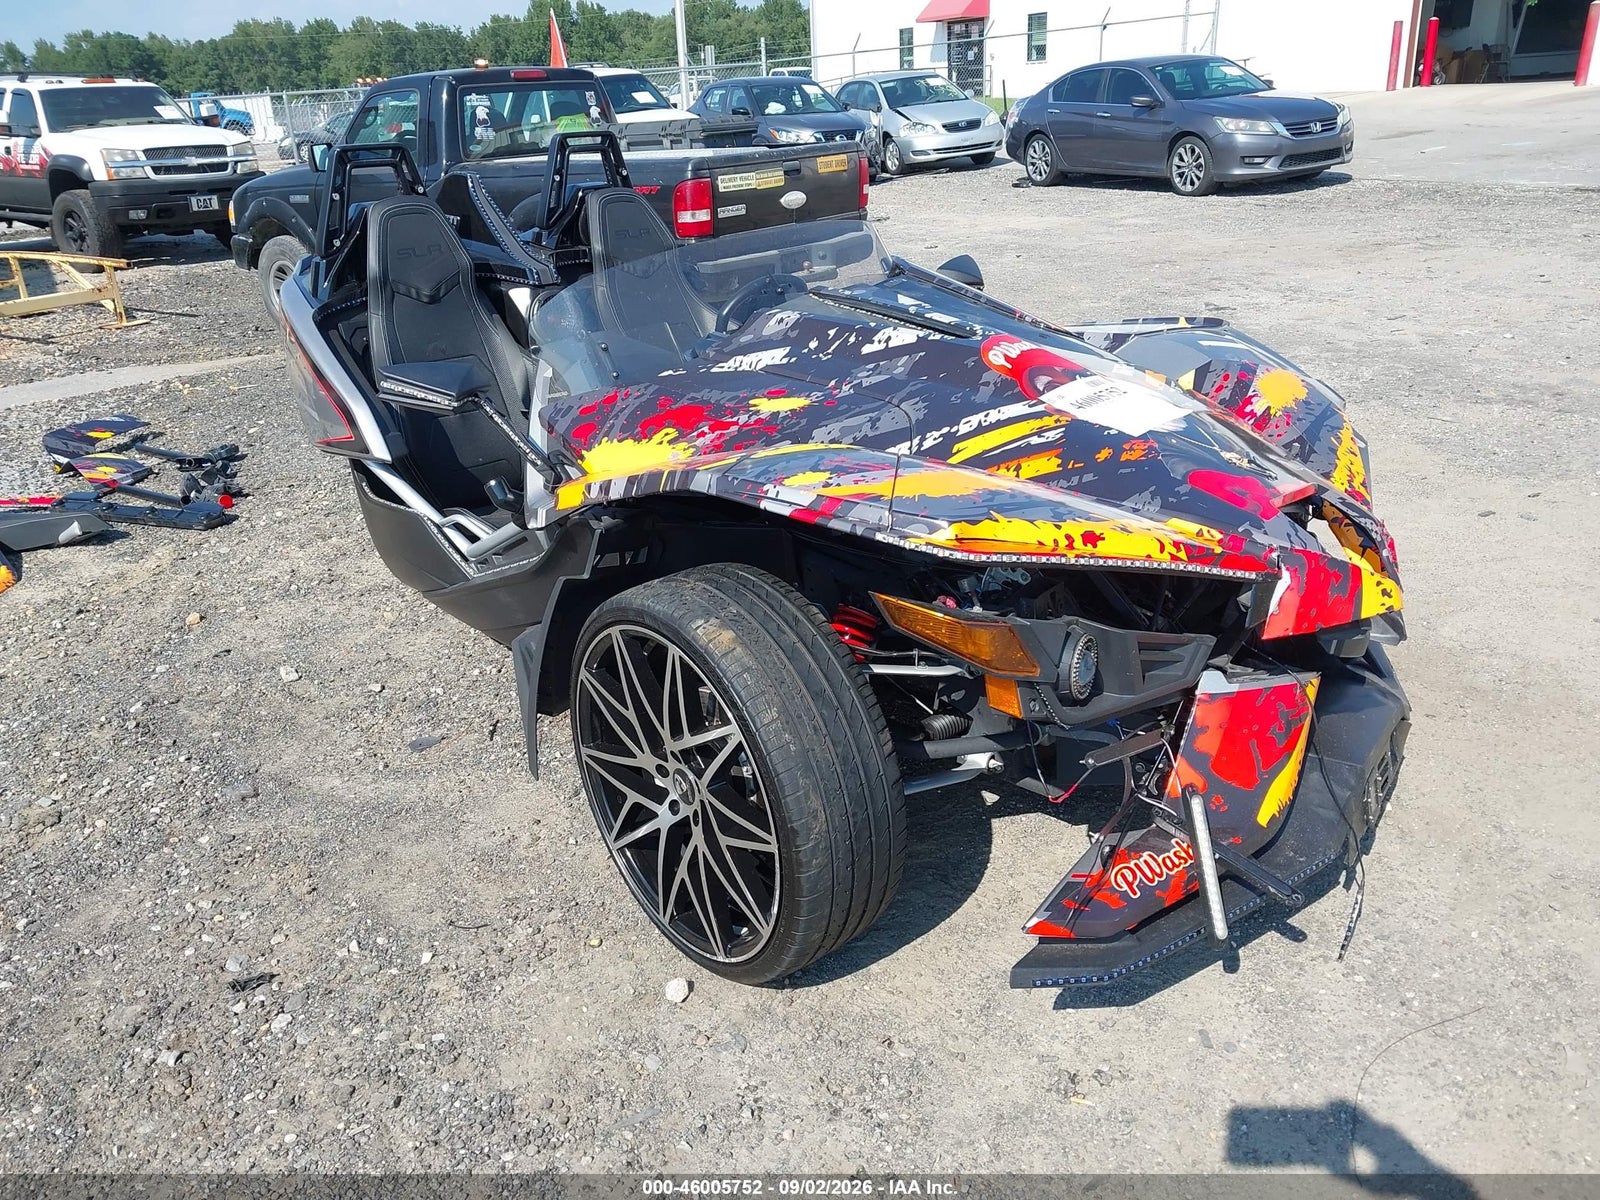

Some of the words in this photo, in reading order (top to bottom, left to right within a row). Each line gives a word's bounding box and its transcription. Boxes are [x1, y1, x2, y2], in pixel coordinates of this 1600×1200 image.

[720, 176, 738, 184] DELIVERY
[739, 174, 754, 182] VEHICLE
[196, 198, 213, 210] CAT
[719, 205, 746, 215] RANGER
[1111, 838, 1194, 899] PWash
